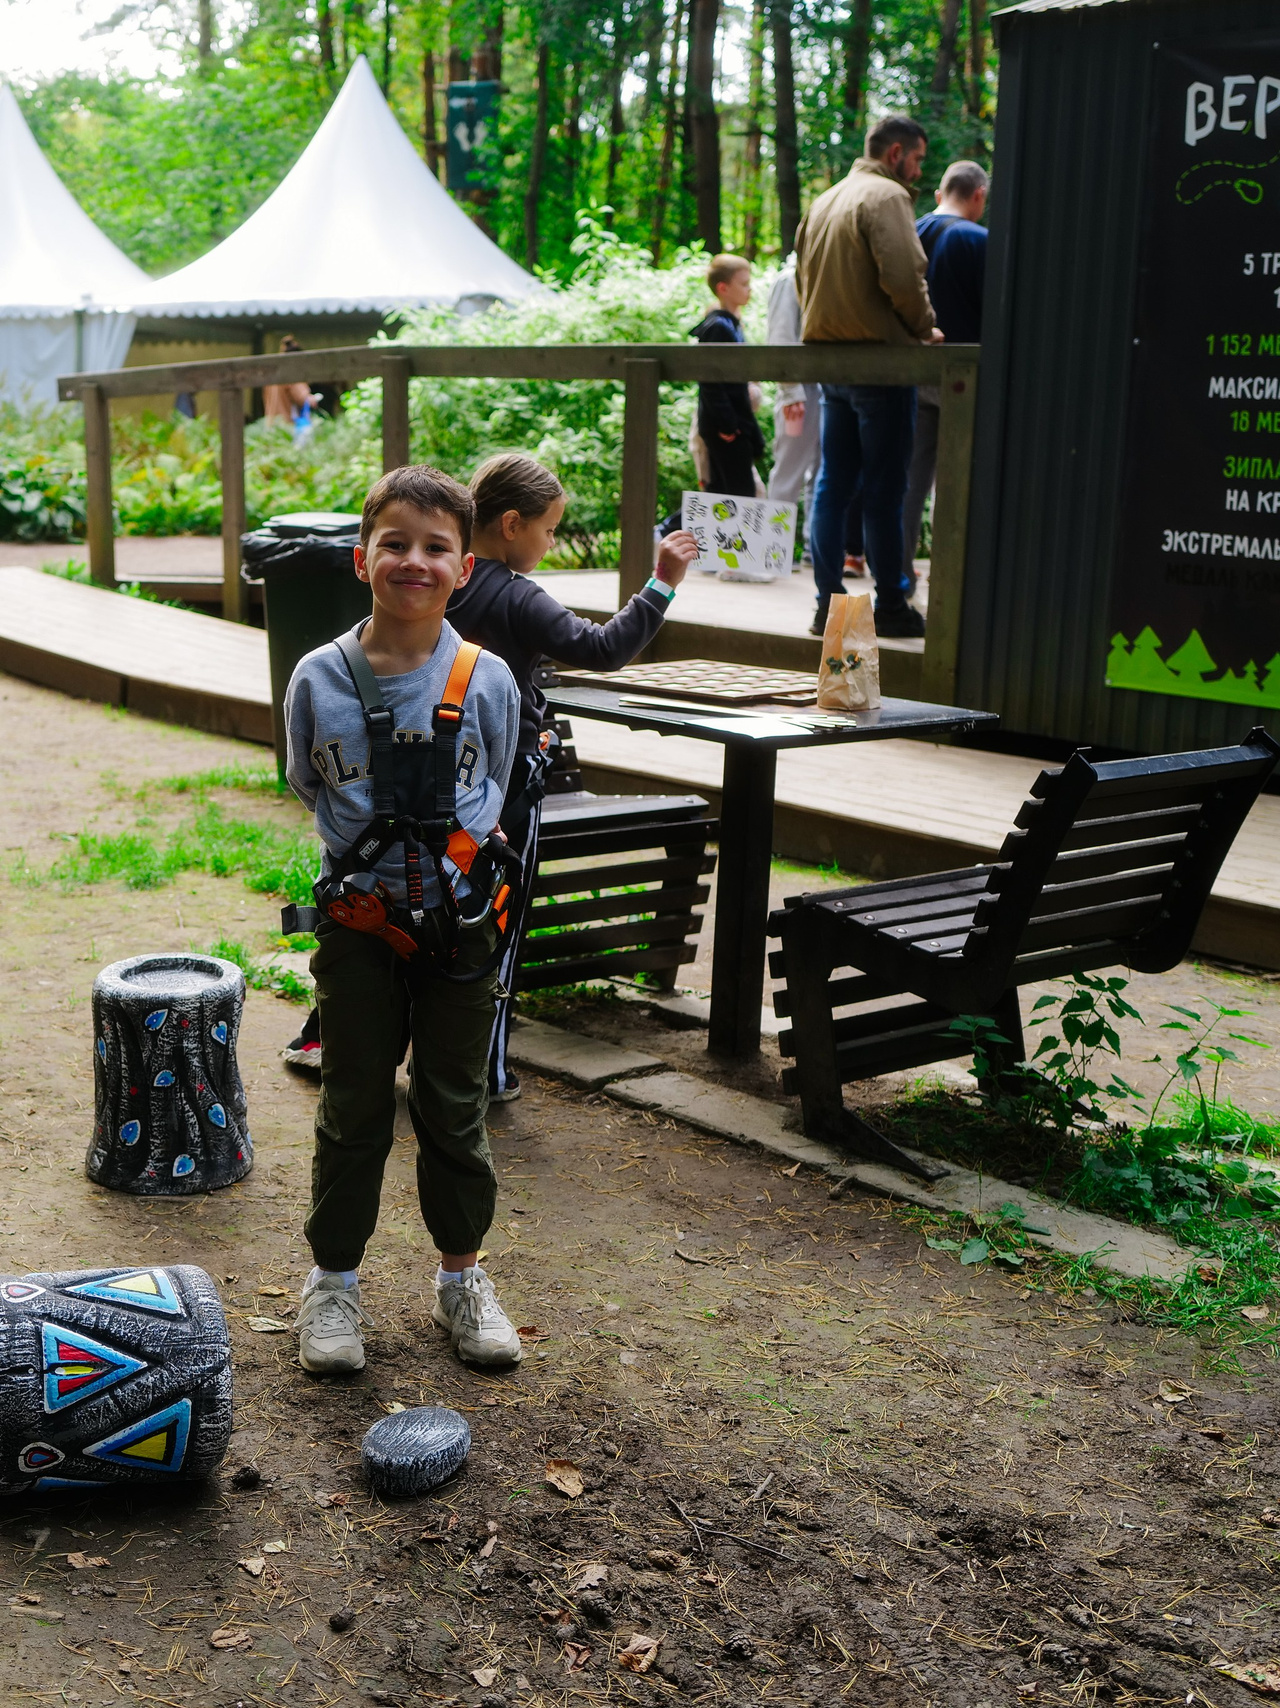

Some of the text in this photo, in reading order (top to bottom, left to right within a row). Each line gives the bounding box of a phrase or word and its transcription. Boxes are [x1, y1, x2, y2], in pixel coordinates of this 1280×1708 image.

[1243, 252, 1255, 276] 5
[1206, 334, 1215, 356] 1
[1221, 334, 1252, 356] 152
[1208, 375, 1280, 401] МАКСИ
[1231, 411, 1250, 433] 18
[1225, 488, 1250, 513] НА
[358, 839, 381, 861] PETZL
